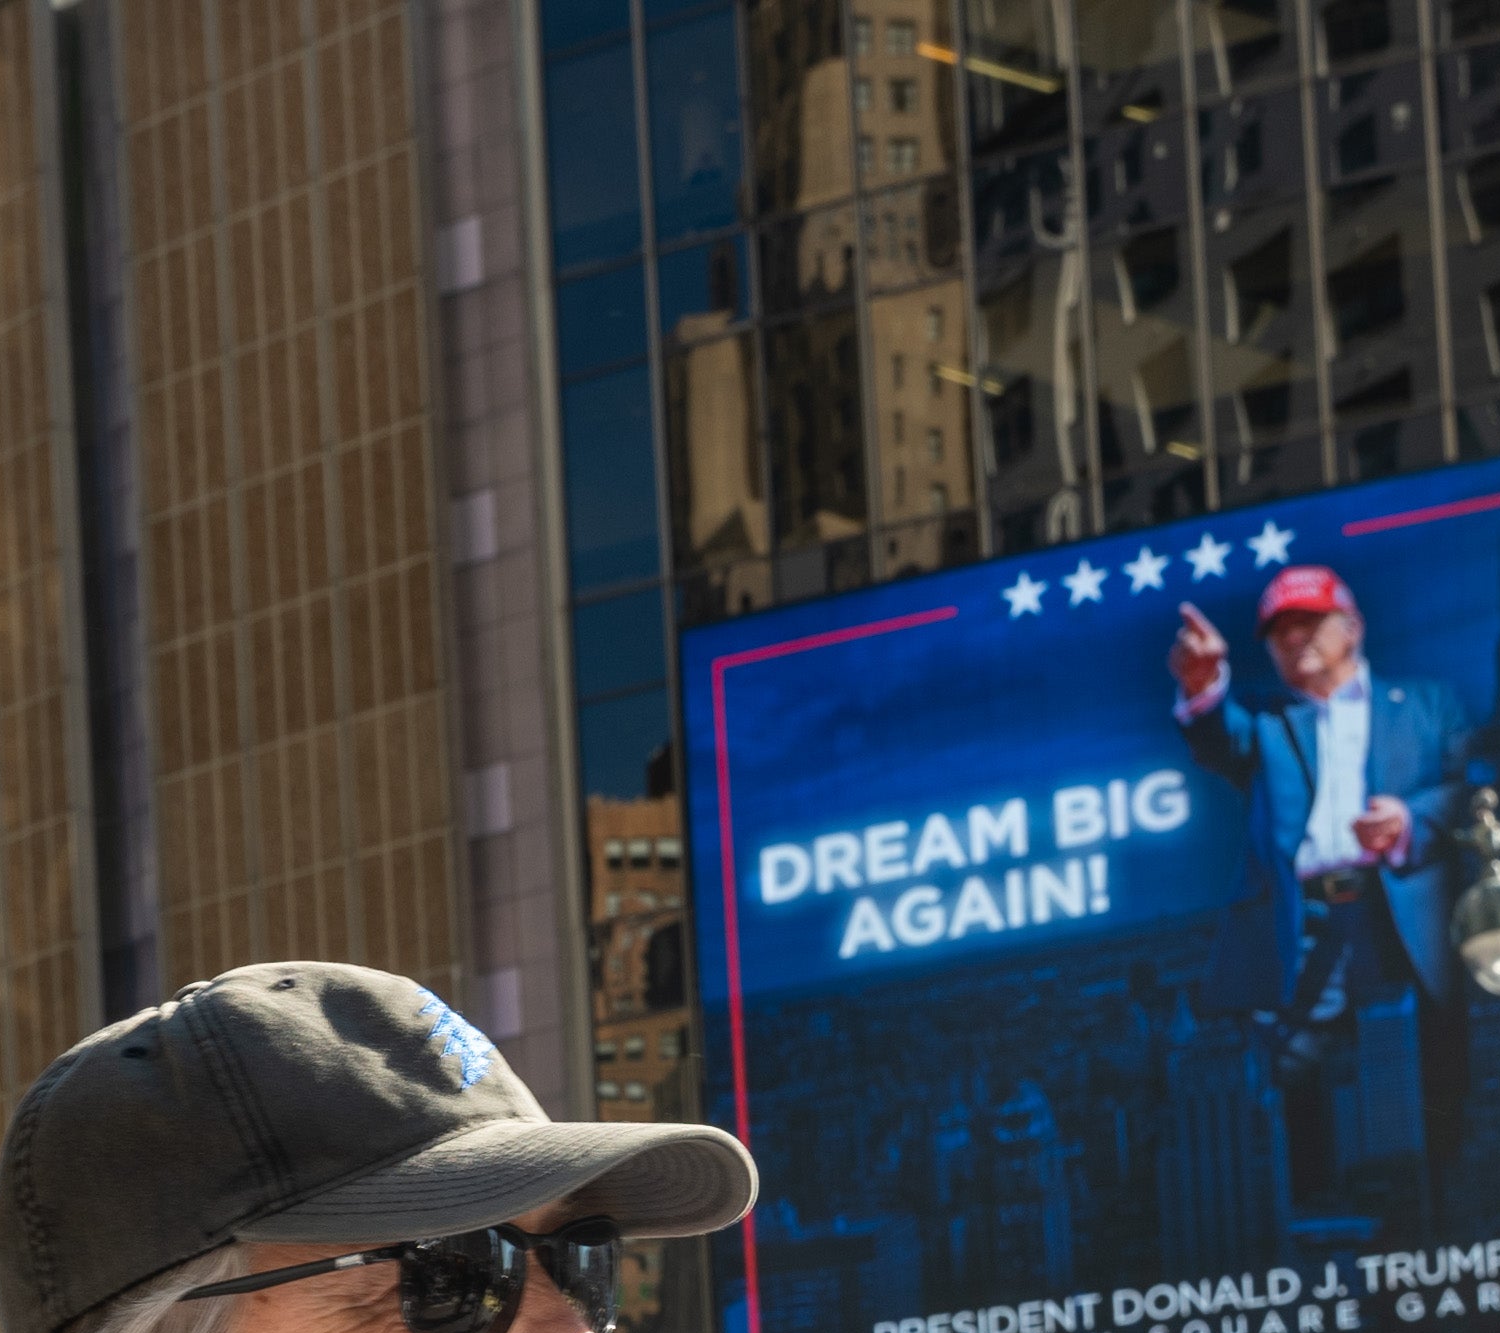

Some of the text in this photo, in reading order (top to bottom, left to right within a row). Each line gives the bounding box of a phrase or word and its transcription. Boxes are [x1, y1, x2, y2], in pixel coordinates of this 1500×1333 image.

[759, 768, 1191, 905] DREAM BIG
[837, 852, 1111, 960] AGAIN!
[1112, 1266, 1303, 1328] DONALD
[1312, 1259, 1349, 1301] J.
